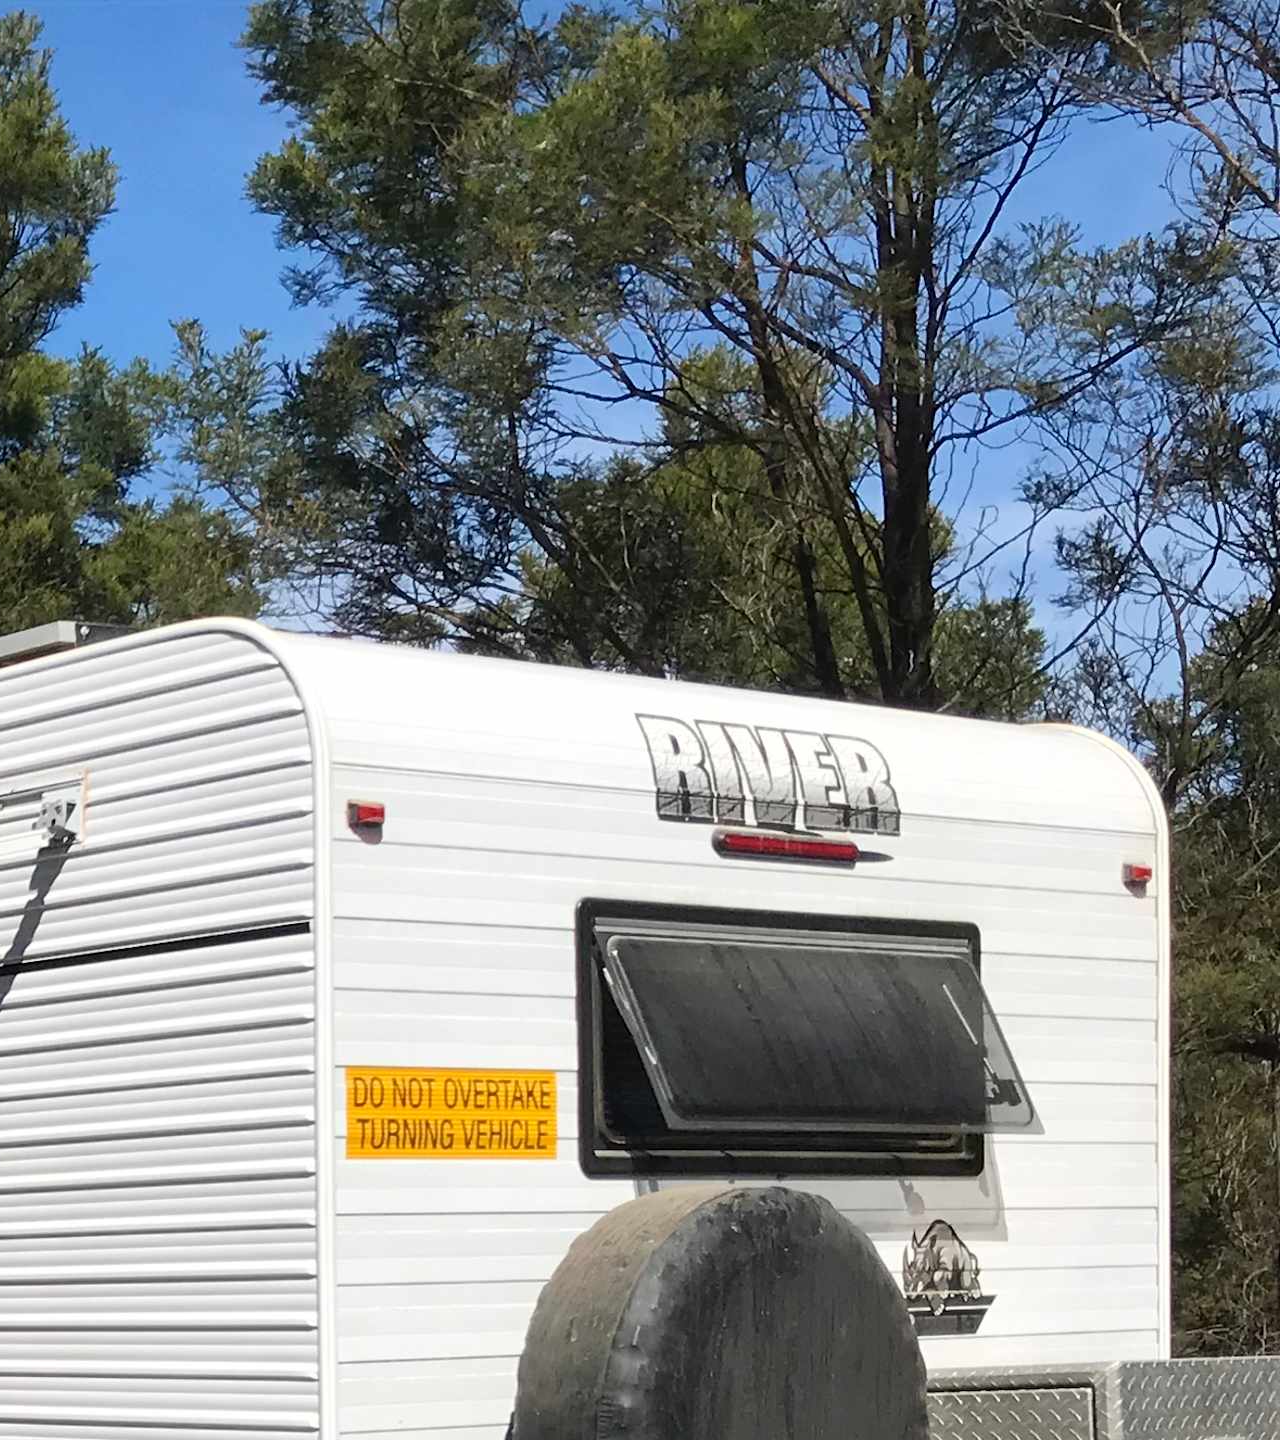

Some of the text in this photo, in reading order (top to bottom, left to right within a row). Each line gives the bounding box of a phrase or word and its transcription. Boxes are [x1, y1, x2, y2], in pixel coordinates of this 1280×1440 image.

[635, 713, 901, 837] RIVER
[352, 1076, 551, 1110] DO NOT OVERTAKE
[356, 1118, 548, 1150] TURNING VEHICLE
